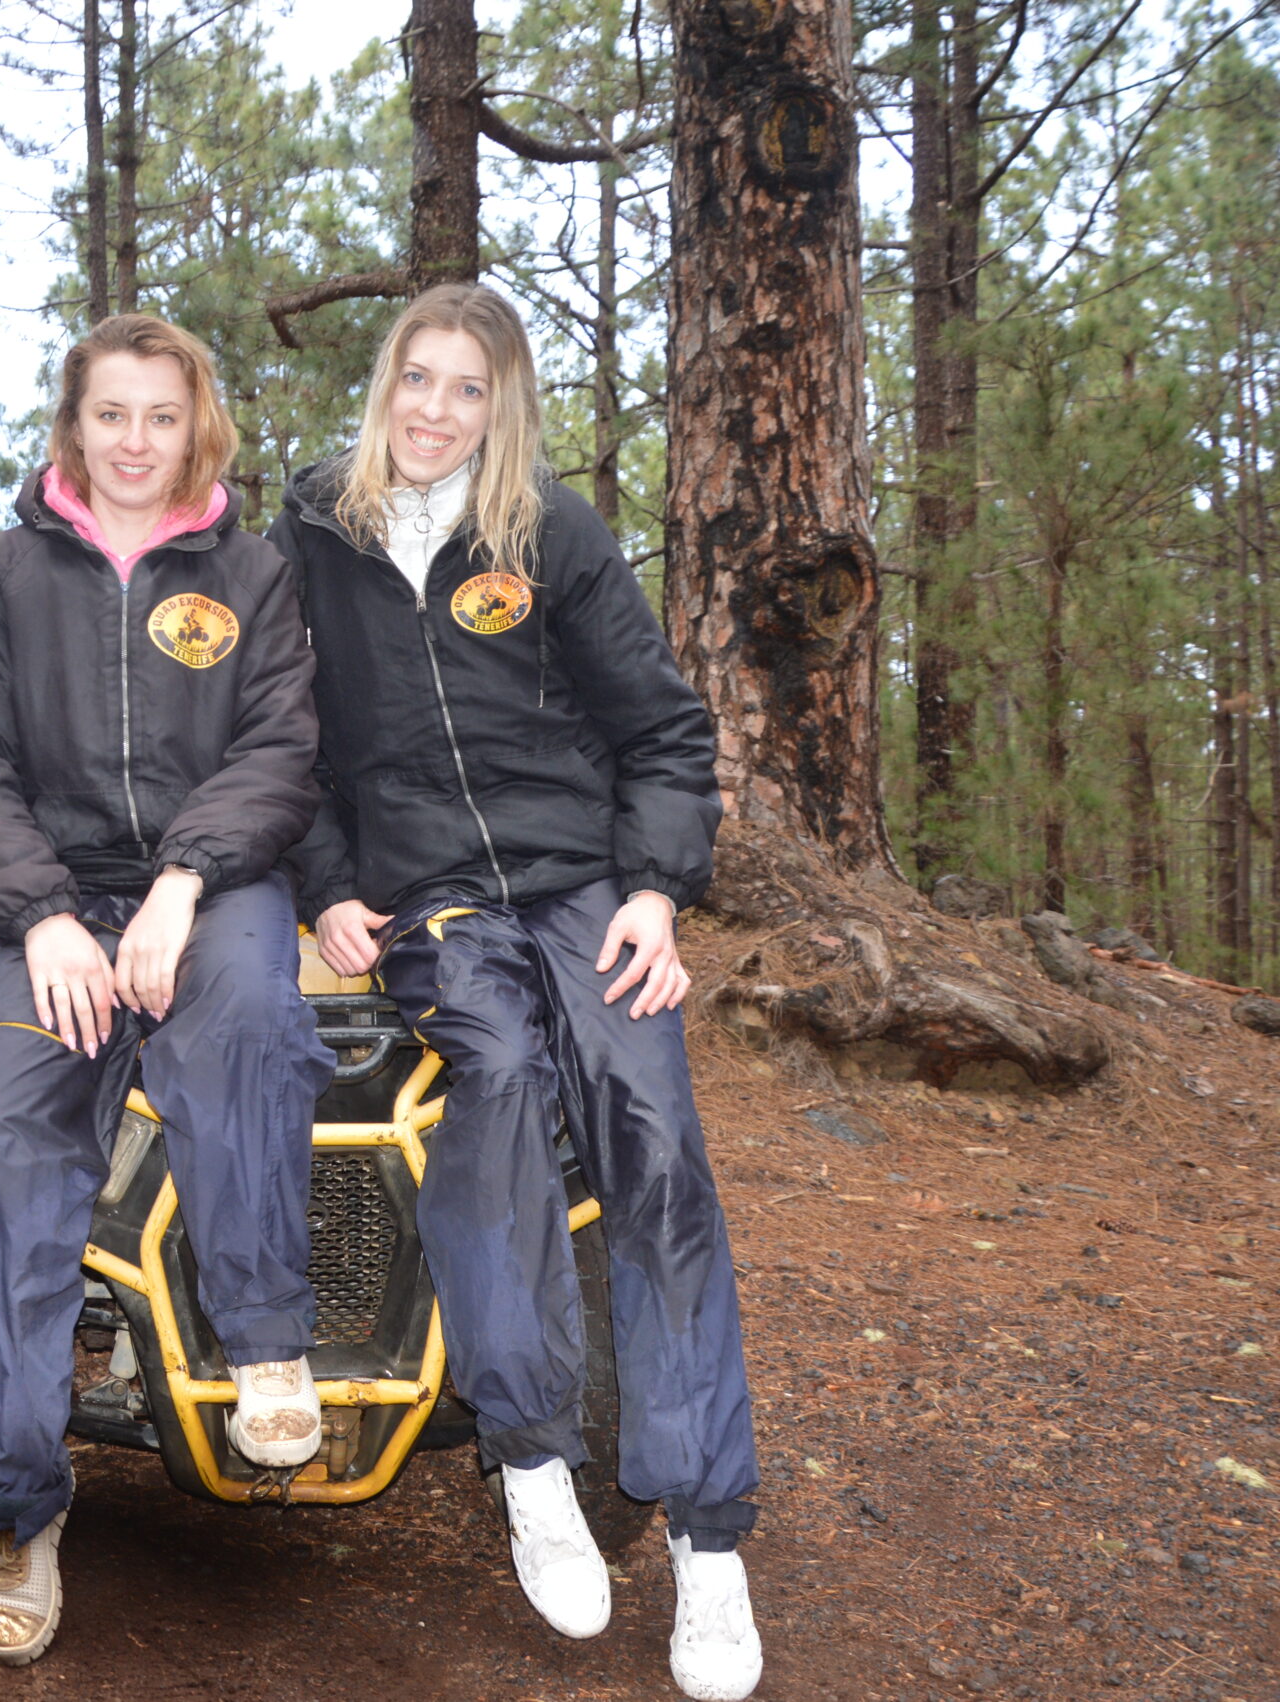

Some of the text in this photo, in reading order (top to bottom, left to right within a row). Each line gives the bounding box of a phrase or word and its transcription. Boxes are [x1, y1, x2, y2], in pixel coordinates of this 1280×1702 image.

[455, 574, 529, 608] QUAD EXCSIOS
[153, 596, 236, 633] QUAD EXCURSIONS
[474, 616, 514, 632] TENERIFE
[173, 645, 216, 665] TENERIFE
